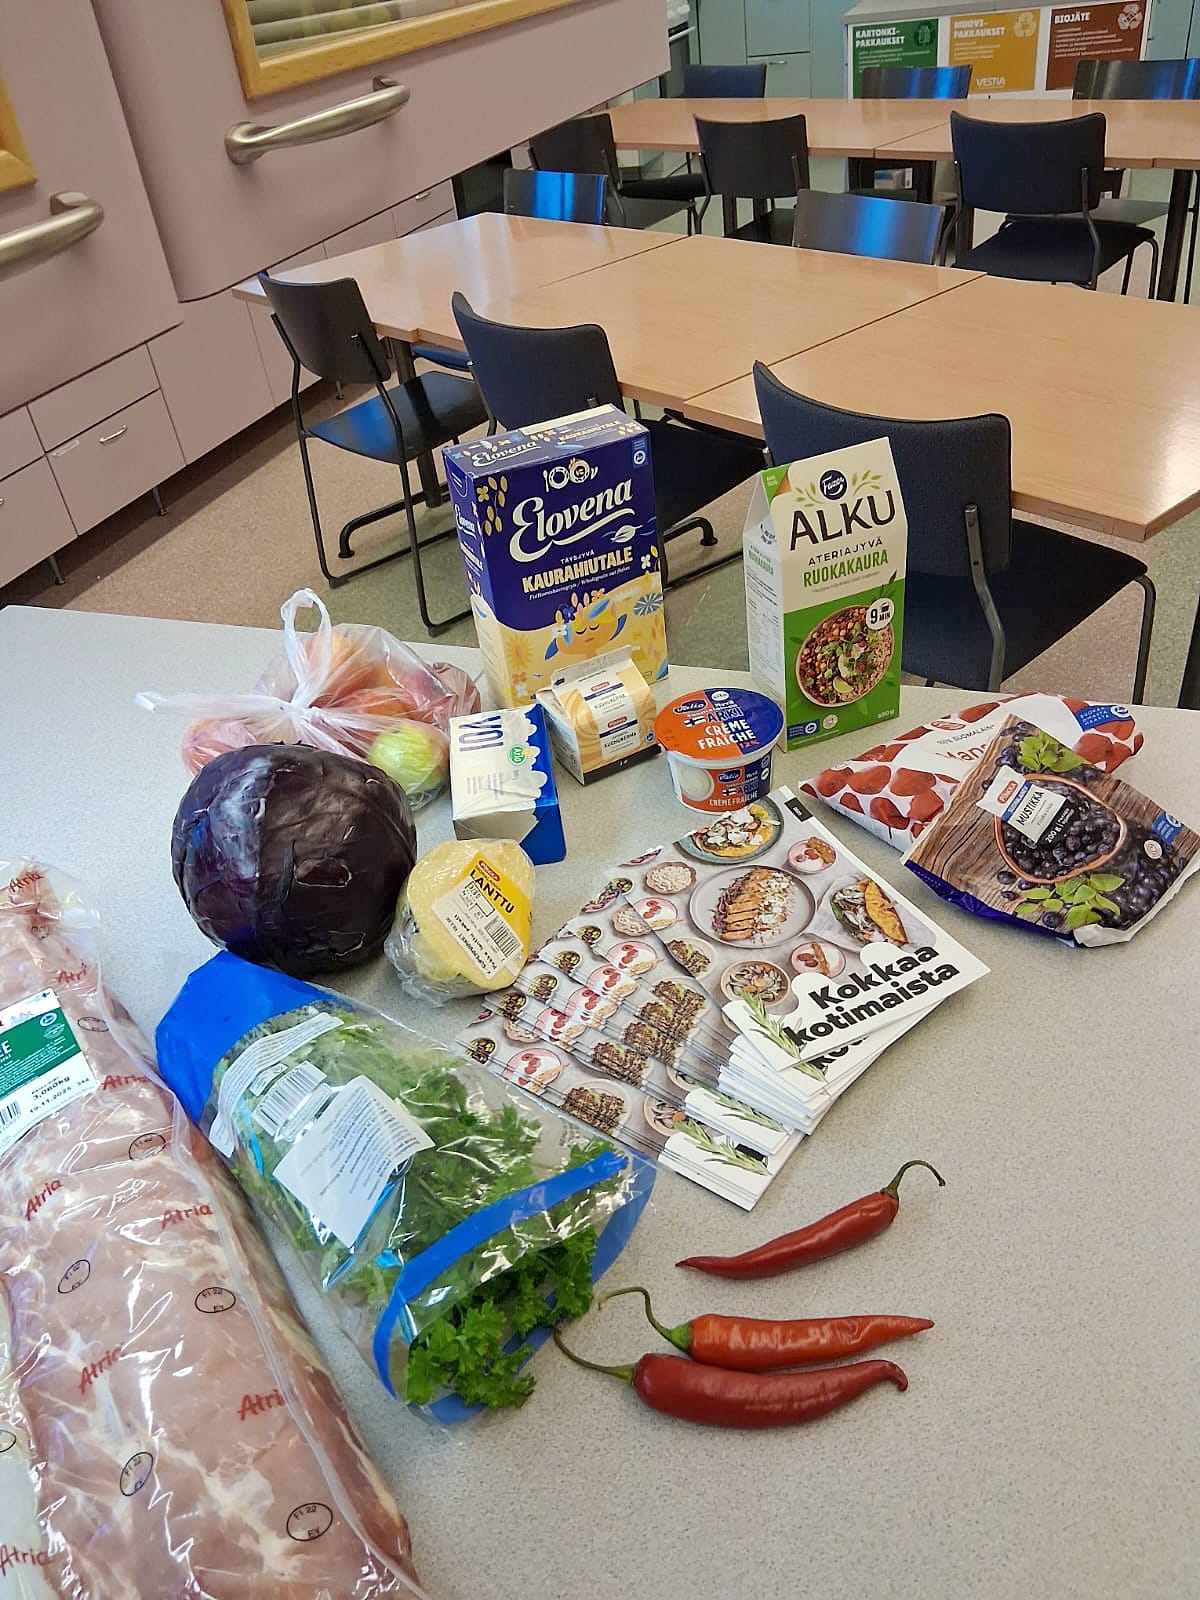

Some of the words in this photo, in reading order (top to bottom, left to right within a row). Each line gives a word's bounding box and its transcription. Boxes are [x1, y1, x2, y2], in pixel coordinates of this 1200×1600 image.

[855, 28, 900, 39] KARTONKI-
[954, 20, 988, 30] MUOVI-
[954, 26, 1006, 38] PAKKAUKSET
[1055, 12, 1090, 24] BIOJÄTE
[855, 36, 905, 48] PAKKAUKSET
[976, 76, 1006, 88] VESTIA
[472, 441, 541, 467] Elovena
[509, 478, 635, 562] Elovena
[789, 490, 896, 551] ALKU
[808, 536, 884, 566] ATERIAJYVÄ
[522, 546, 634, 593] KAURAHIUTALE
[803, 549, 889, 588] RUOKAKAURA
[870, 608, 878, 624] 9
[458, 715, 504, 752] VOI
[1015, 791, 1045, 826] MUSTIKKA
[9, 870, 45, 892] Atria
[469, 869, 515, 914] LANTTU
[808, 946, 939, 1010] Kokkaa
[783, 962, 961, 1047] kotimaista
[25, 1178, 64, 1221] Atria
[160, 1203, 214, 1230] Atria
[238, 1388, 287, 1421] Atri
